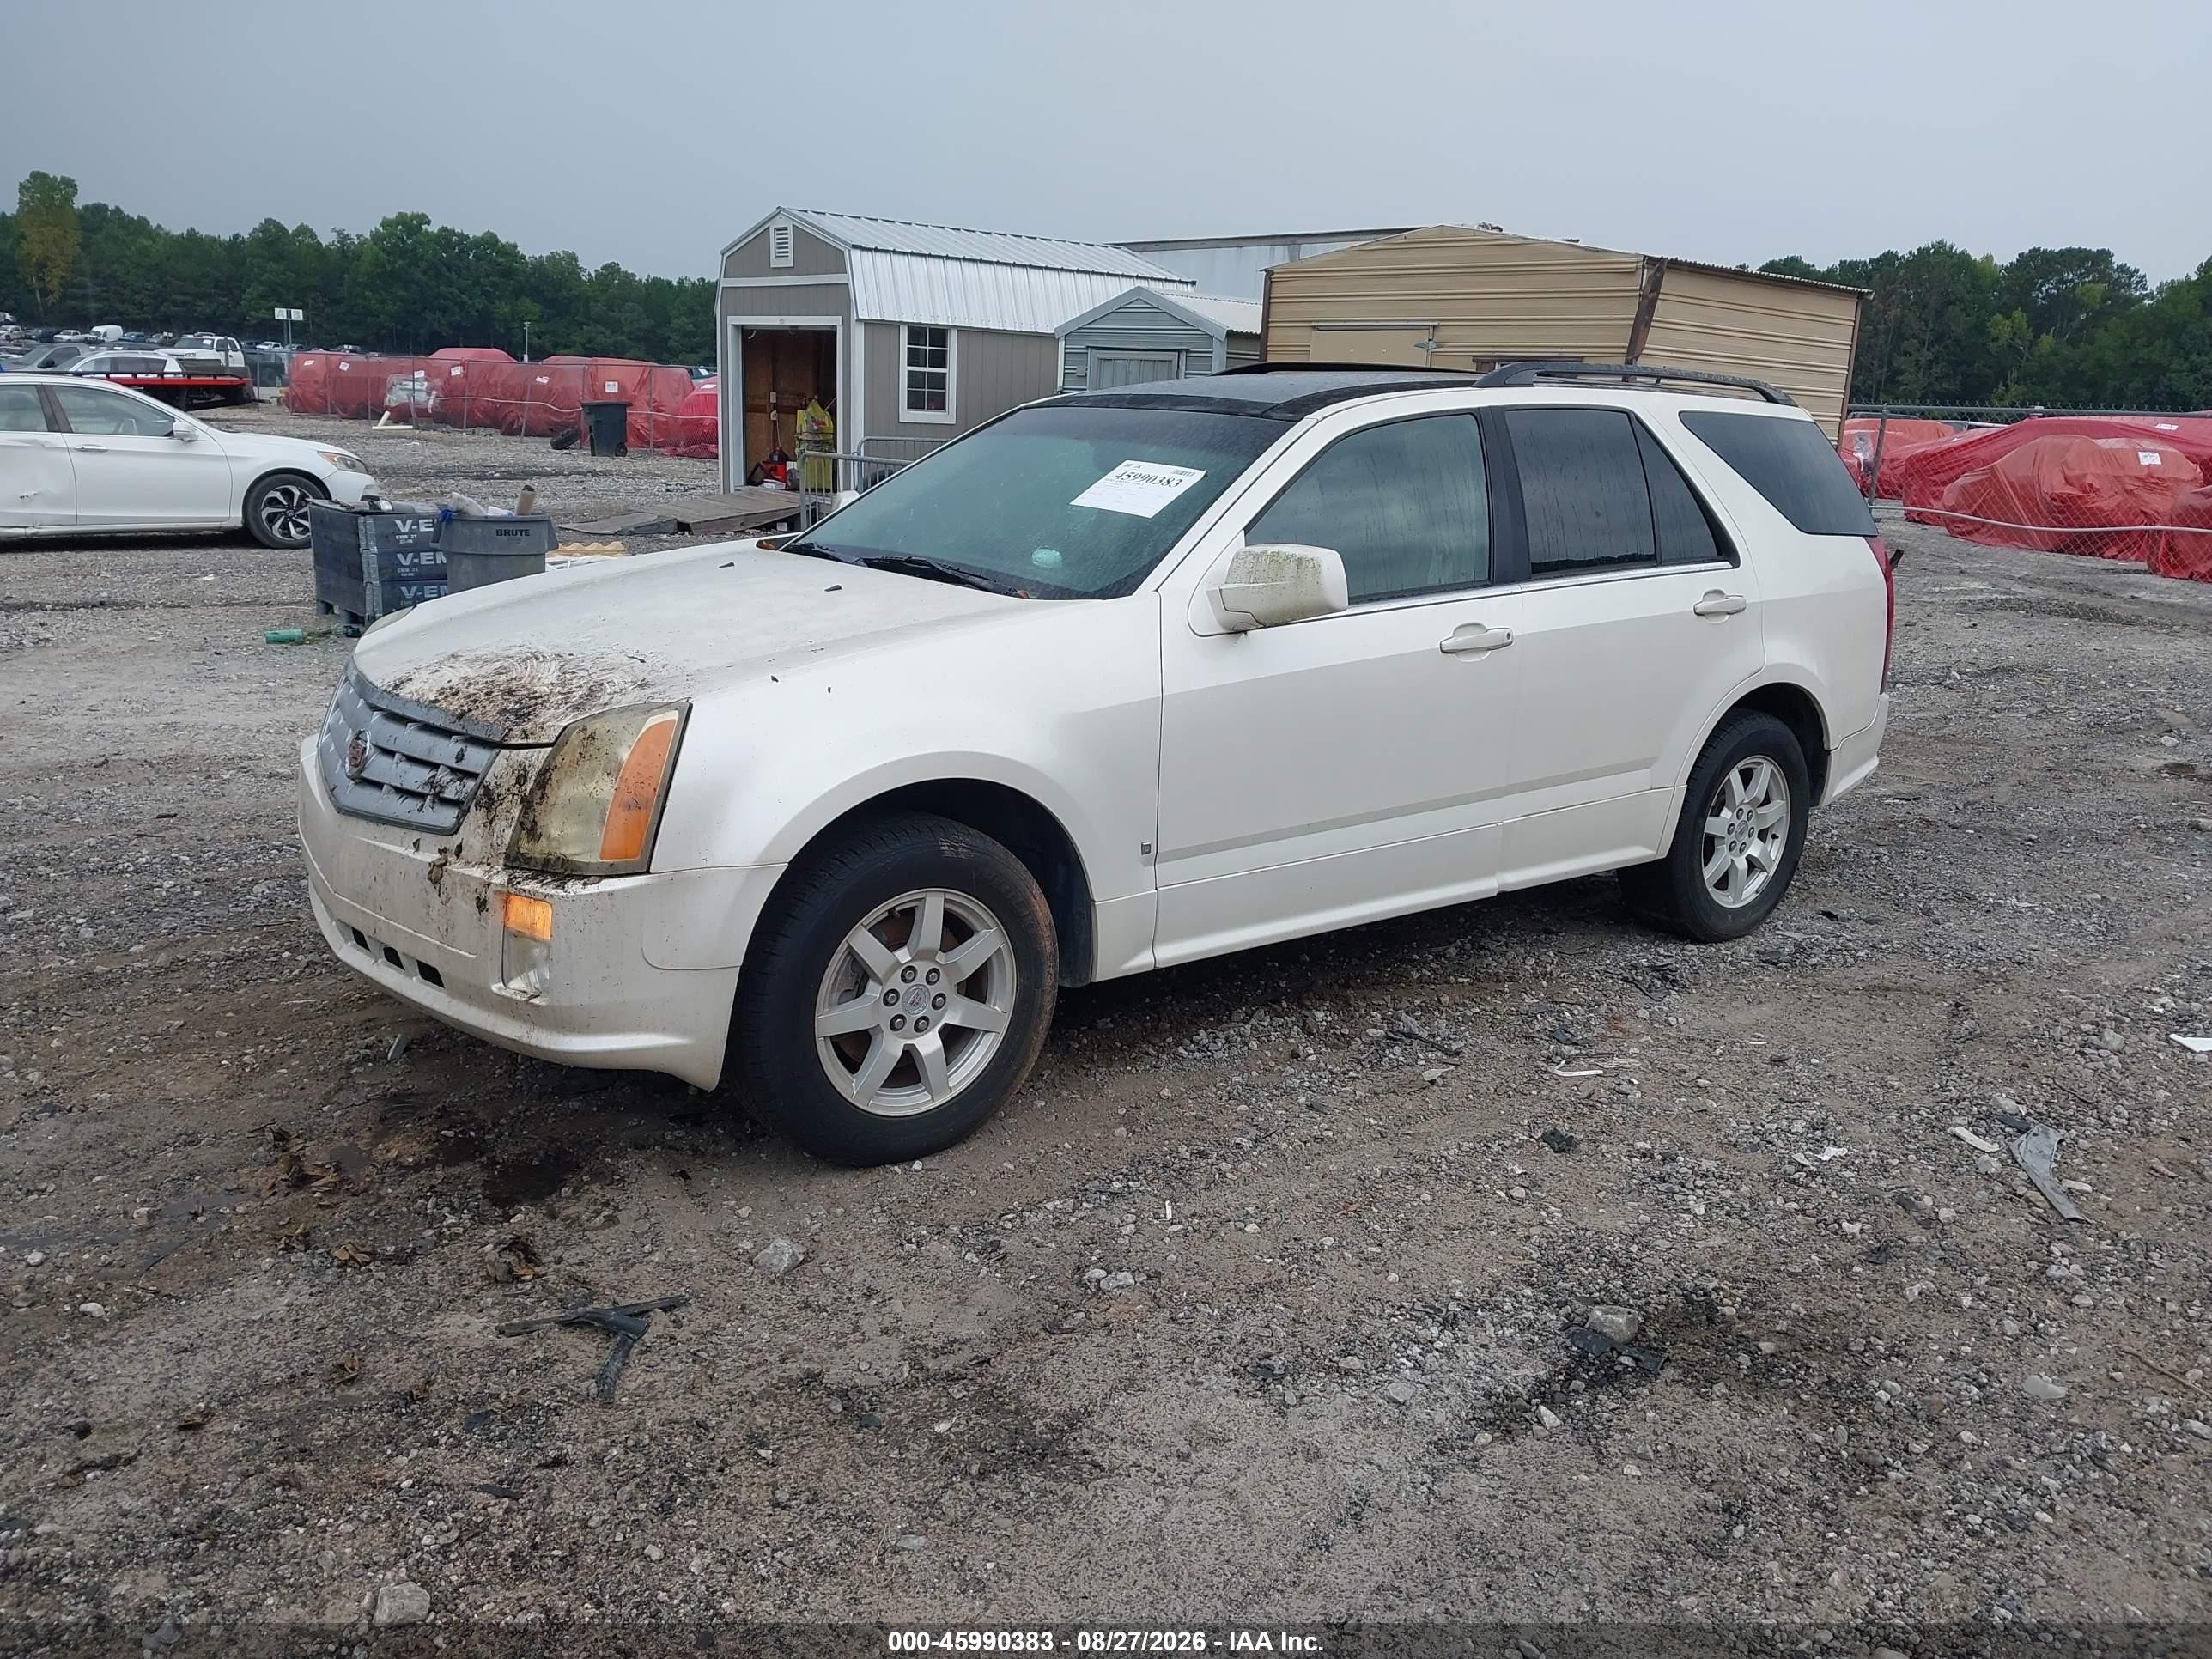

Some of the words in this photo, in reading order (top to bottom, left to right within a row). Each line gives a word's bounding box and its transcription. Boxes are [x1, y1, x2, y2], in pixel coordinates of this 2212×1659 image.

[276, 309, 285, 318] A
[1115, 471, 1183, 489] 45990383
[394, 518, 436, 532] V-E
[495, 528, 530, 537] BRUTE
